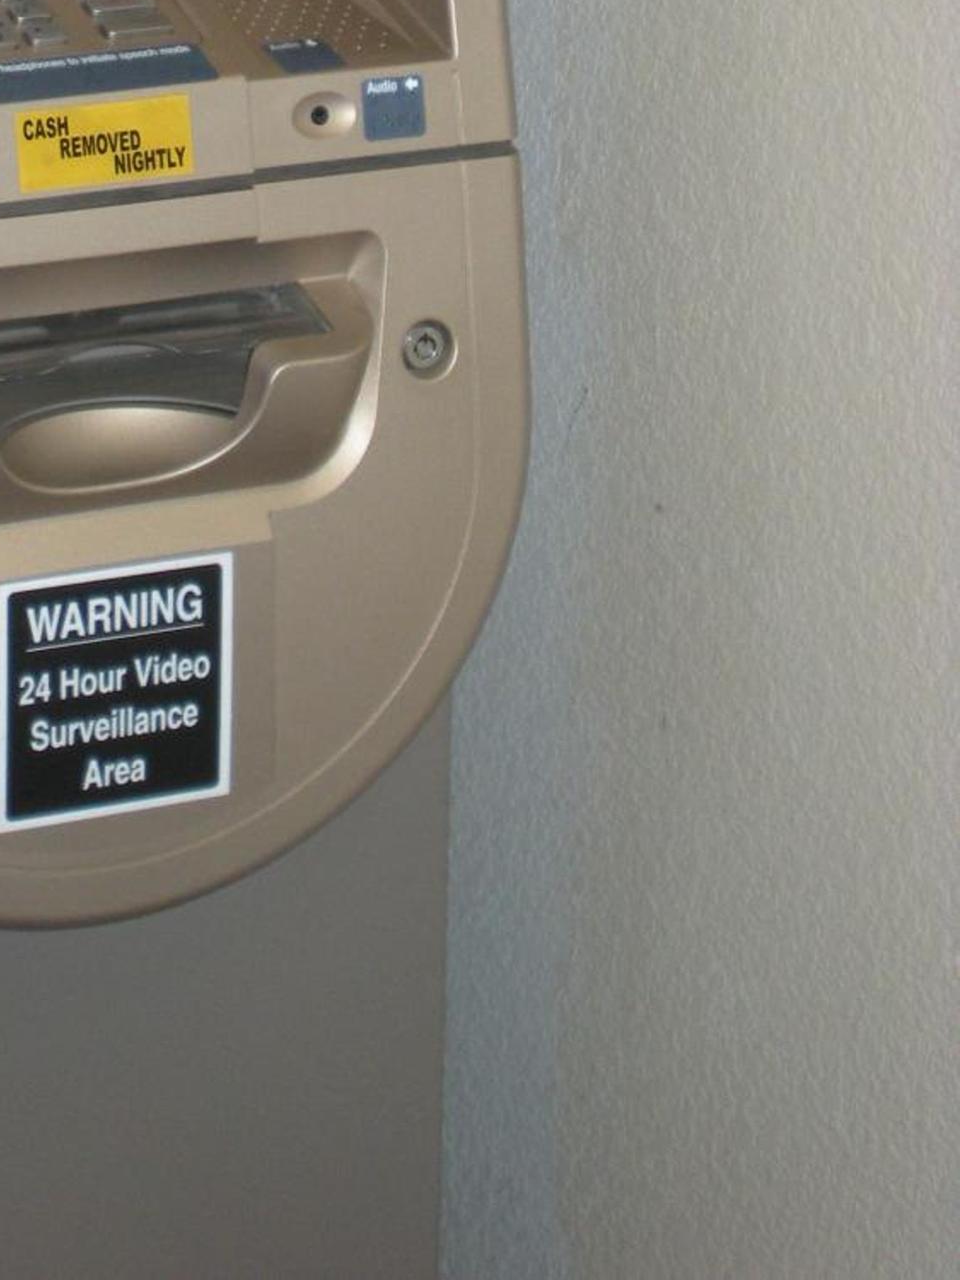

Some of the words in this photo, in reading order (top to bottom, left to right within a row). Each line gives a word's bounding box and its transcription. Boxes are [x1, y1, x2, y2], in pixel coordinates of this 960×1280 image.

[366, 78, 398, 96] Audio
[23, 116, 69, 141] CASH
[59, 129, 141, 159] REMOVED
[113, 146, 186, 175] NIGHTLY
[26, 583, 204, 644] WARNING
[18, 672, 52, 706] 24
[59, 667, 127, 701] Hour
[134, 652, 211, 688] Video
[30, 701, 199, 752] Surveillance
[82, 757, 146, 792] Area
